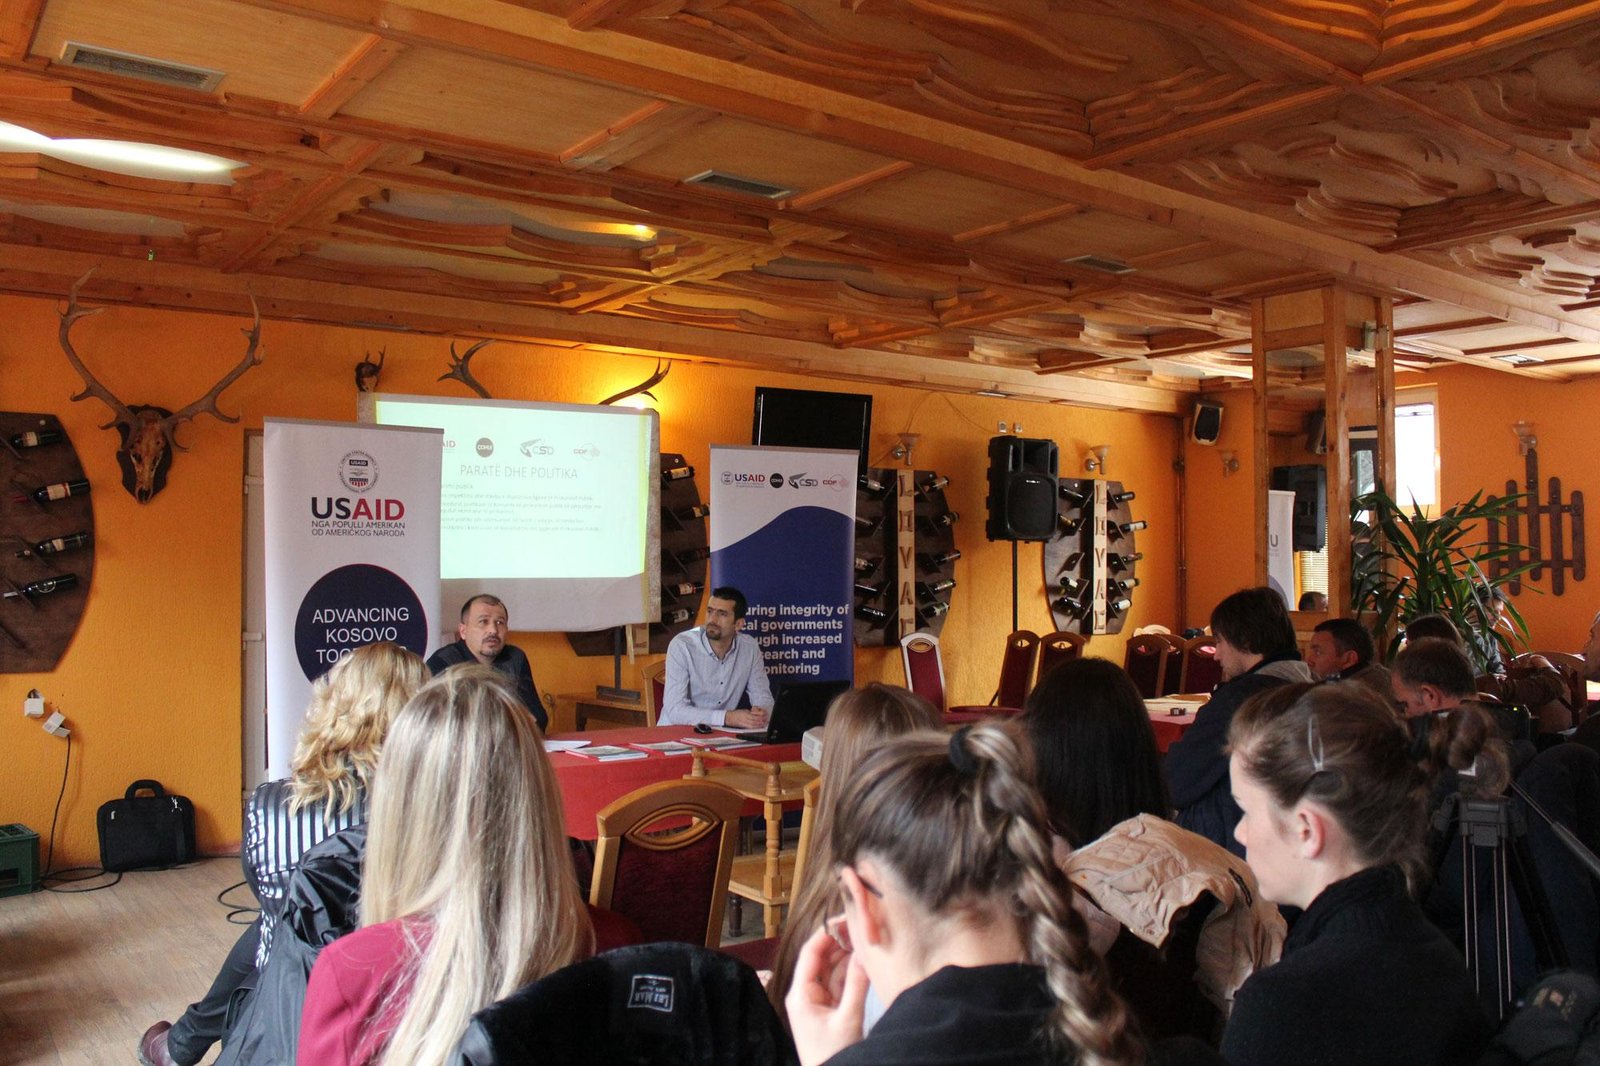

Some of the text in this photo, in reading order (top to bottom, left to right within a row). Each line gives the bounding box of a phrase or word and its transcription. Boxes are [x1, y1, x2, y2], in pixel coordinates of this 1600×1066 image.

[504, 466, 527, 478] DHE
[530, 466, 578, 479] POLITIKA
[734, 473, 765, 483] USAID
[311, 496, 405, 521] USAID
[332, 521, 364, 529] POPULLI
[365, 521, 406, 529] AMERIKAN
[311, 528, 324, 536] OD
[373, 529, 405, 537] NARODA
[312, 607, 409, 624] ADVANCING
[745, 604, 849, 617] uring integrity of
[761, 619, 843, 632] governments
[326, 626, 397, 643] KOSOVO
[782, 633, 842, 645] increased
[802, 648, 826, 659] and
[764, 663, 820, 675] onitoring
